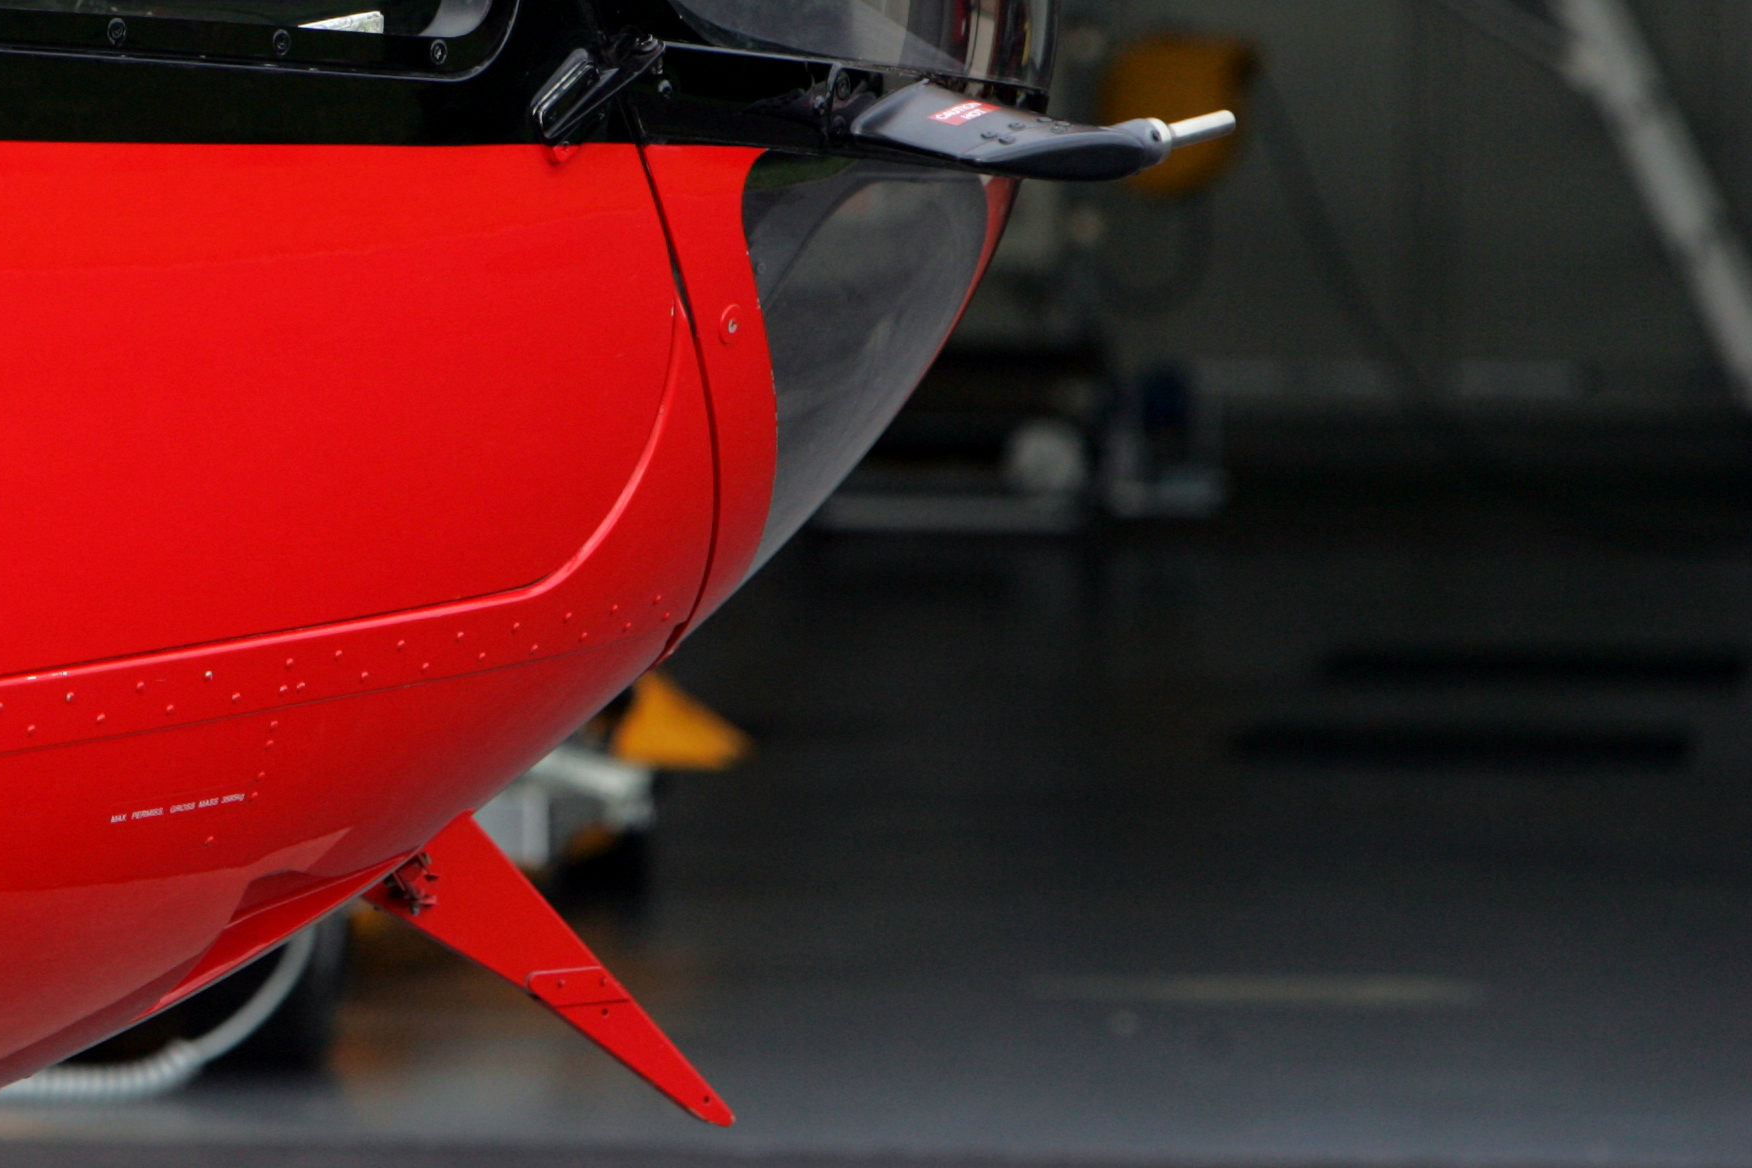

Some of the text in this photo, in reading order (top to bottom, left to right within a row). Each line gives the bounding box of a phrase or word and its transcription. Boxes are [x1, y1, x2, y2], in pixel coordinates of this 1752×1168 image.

[935, 102, 983, 120] CAUTION
[960, 108, 987, 120] HOT
[198, 797, 220, 808] MASS
